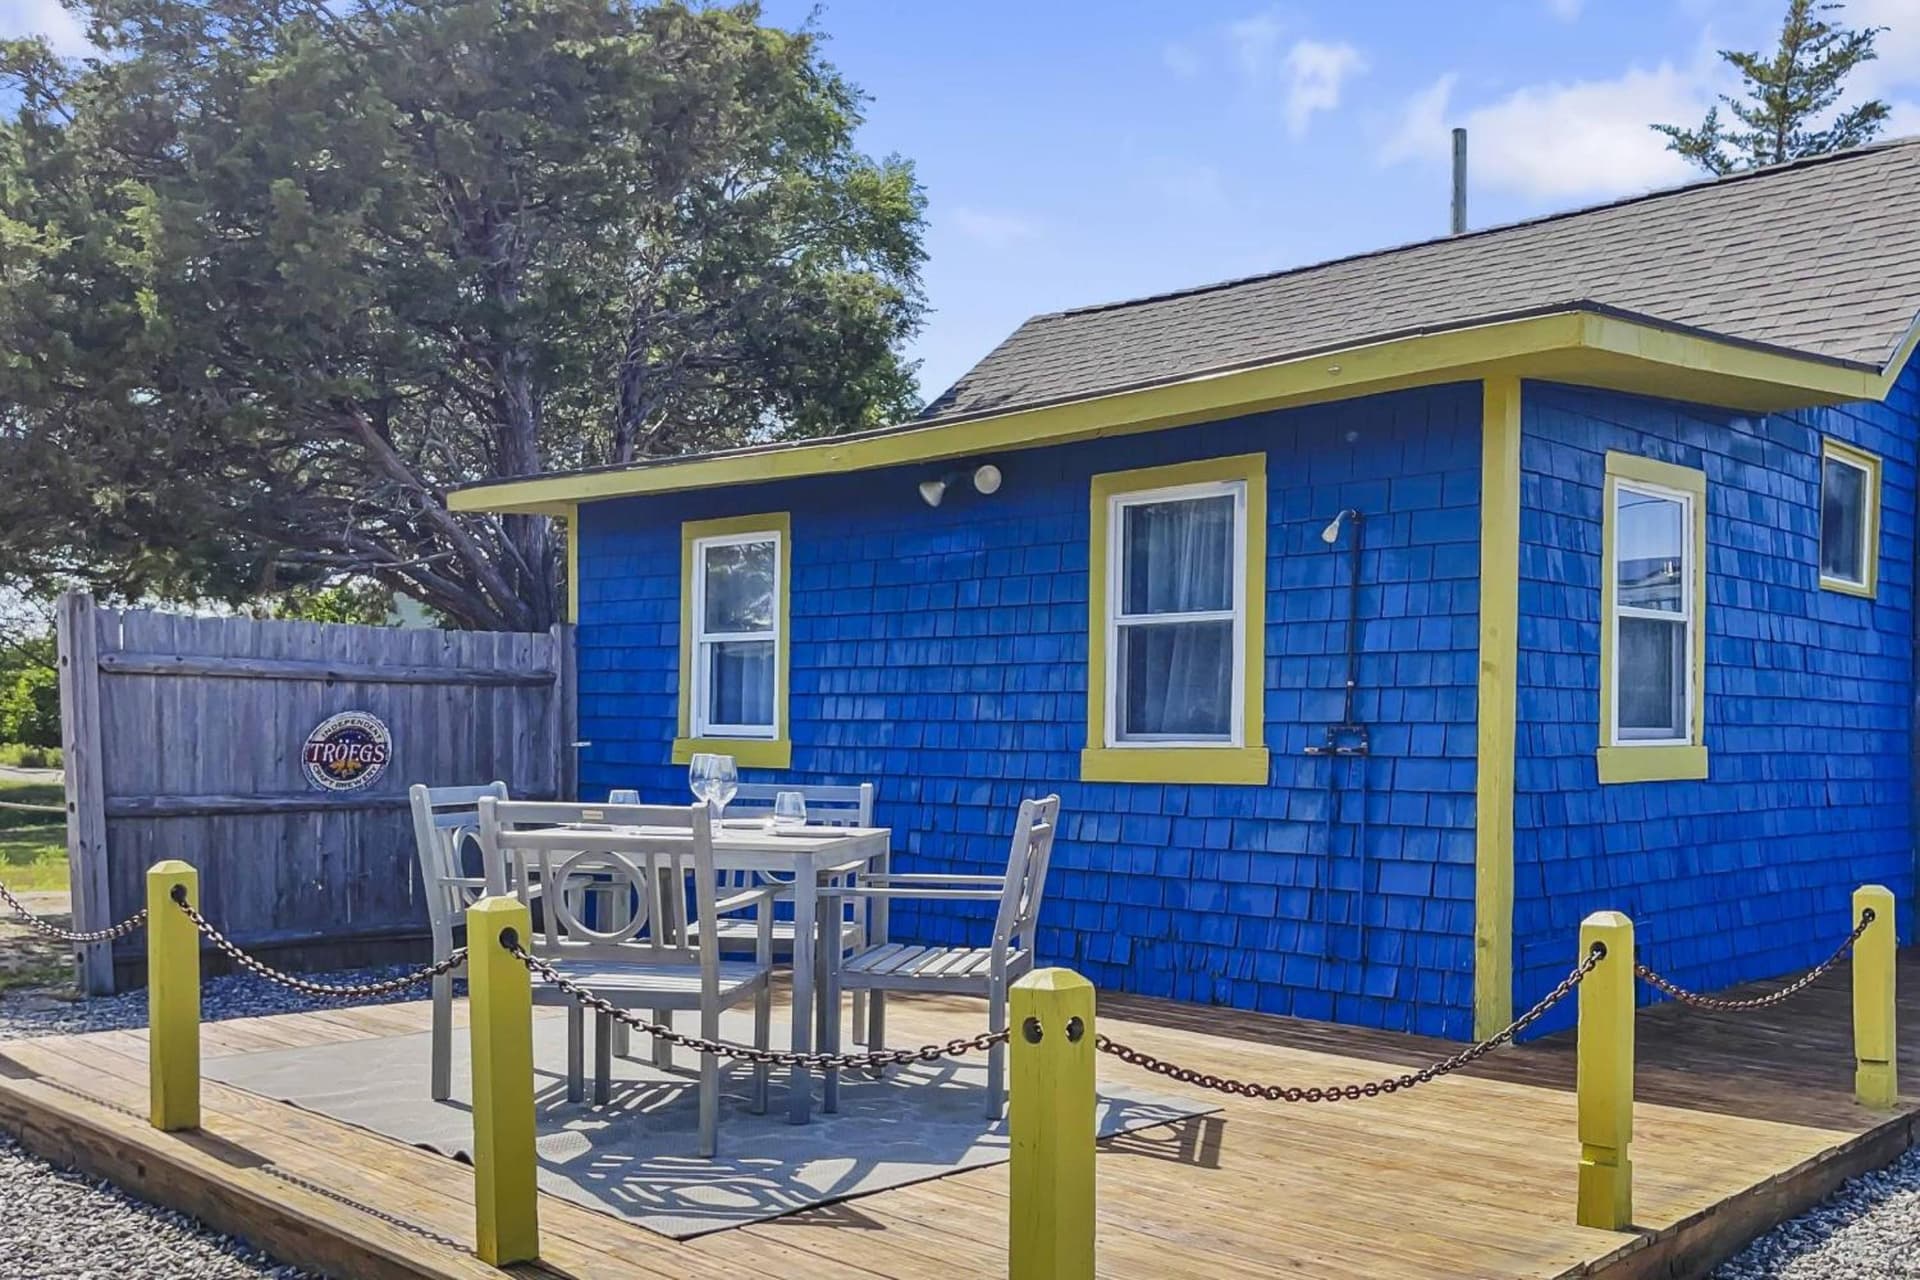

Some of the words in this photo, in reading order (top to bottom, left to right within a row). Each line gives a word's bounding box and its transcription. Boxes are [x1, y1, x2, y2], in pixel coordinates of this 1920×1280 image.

[321, 719, 382, 738] INDEPENDENT
[313, 764, 334, 786] CRAFT
[335, 766, 377, 788] BREWERY
